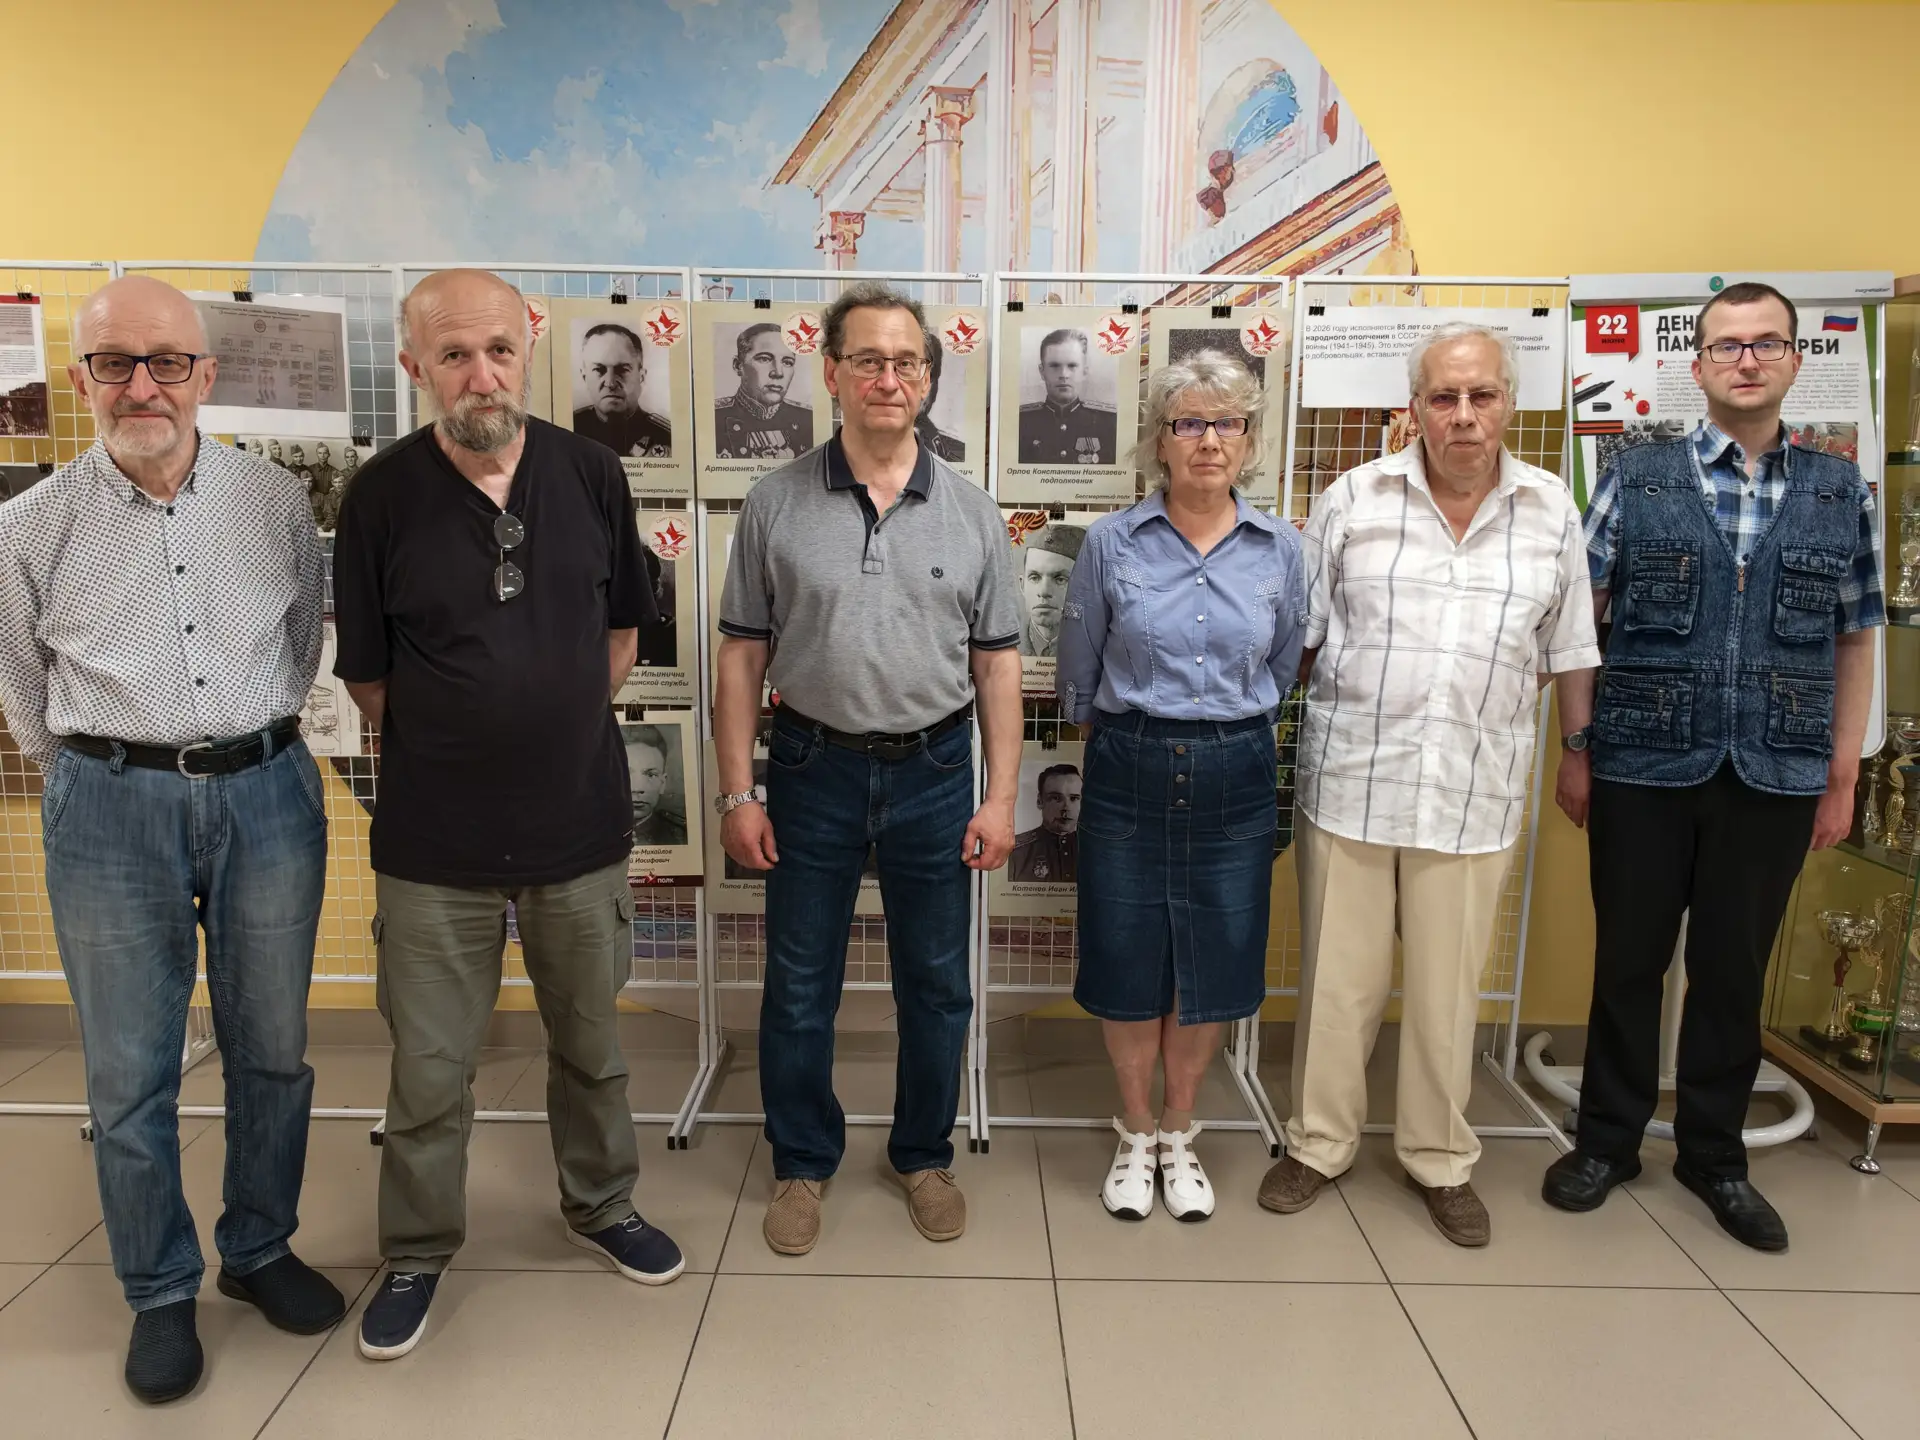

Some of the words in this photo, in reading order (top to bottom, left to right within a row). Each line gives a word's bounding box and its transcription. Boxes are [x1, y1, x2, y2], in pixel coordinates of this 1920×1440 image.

[1312, 324, 1331, 332] 2026
[1332, 325, 1349, 333] году
[1597, 314, 1628, 335] 22
[1656, 315, 1699, 334] ДЕН
[1305, 334, 1347, 342] народного
[1657, 335, 1699, 352] ПАМ
[1798, 338, 1840, 355] РБИ
[1311, 351, 1366, 360] добровольцах,
[643, 461, 680, 469] Иванович
[705, 465, 755, 473] Артюшенко
[1006, 467, 1031, 475] Орлов
[1032, 468, 1081, 476] Константин
[1082, 468, 1127, 476] Николаевич
[1040, 477, 1094, 485] подполковник
[641, 670, 685, 678] Ильинична
[660, 679, 689, 687] службы
[719, 882, 742, 891] Попов
